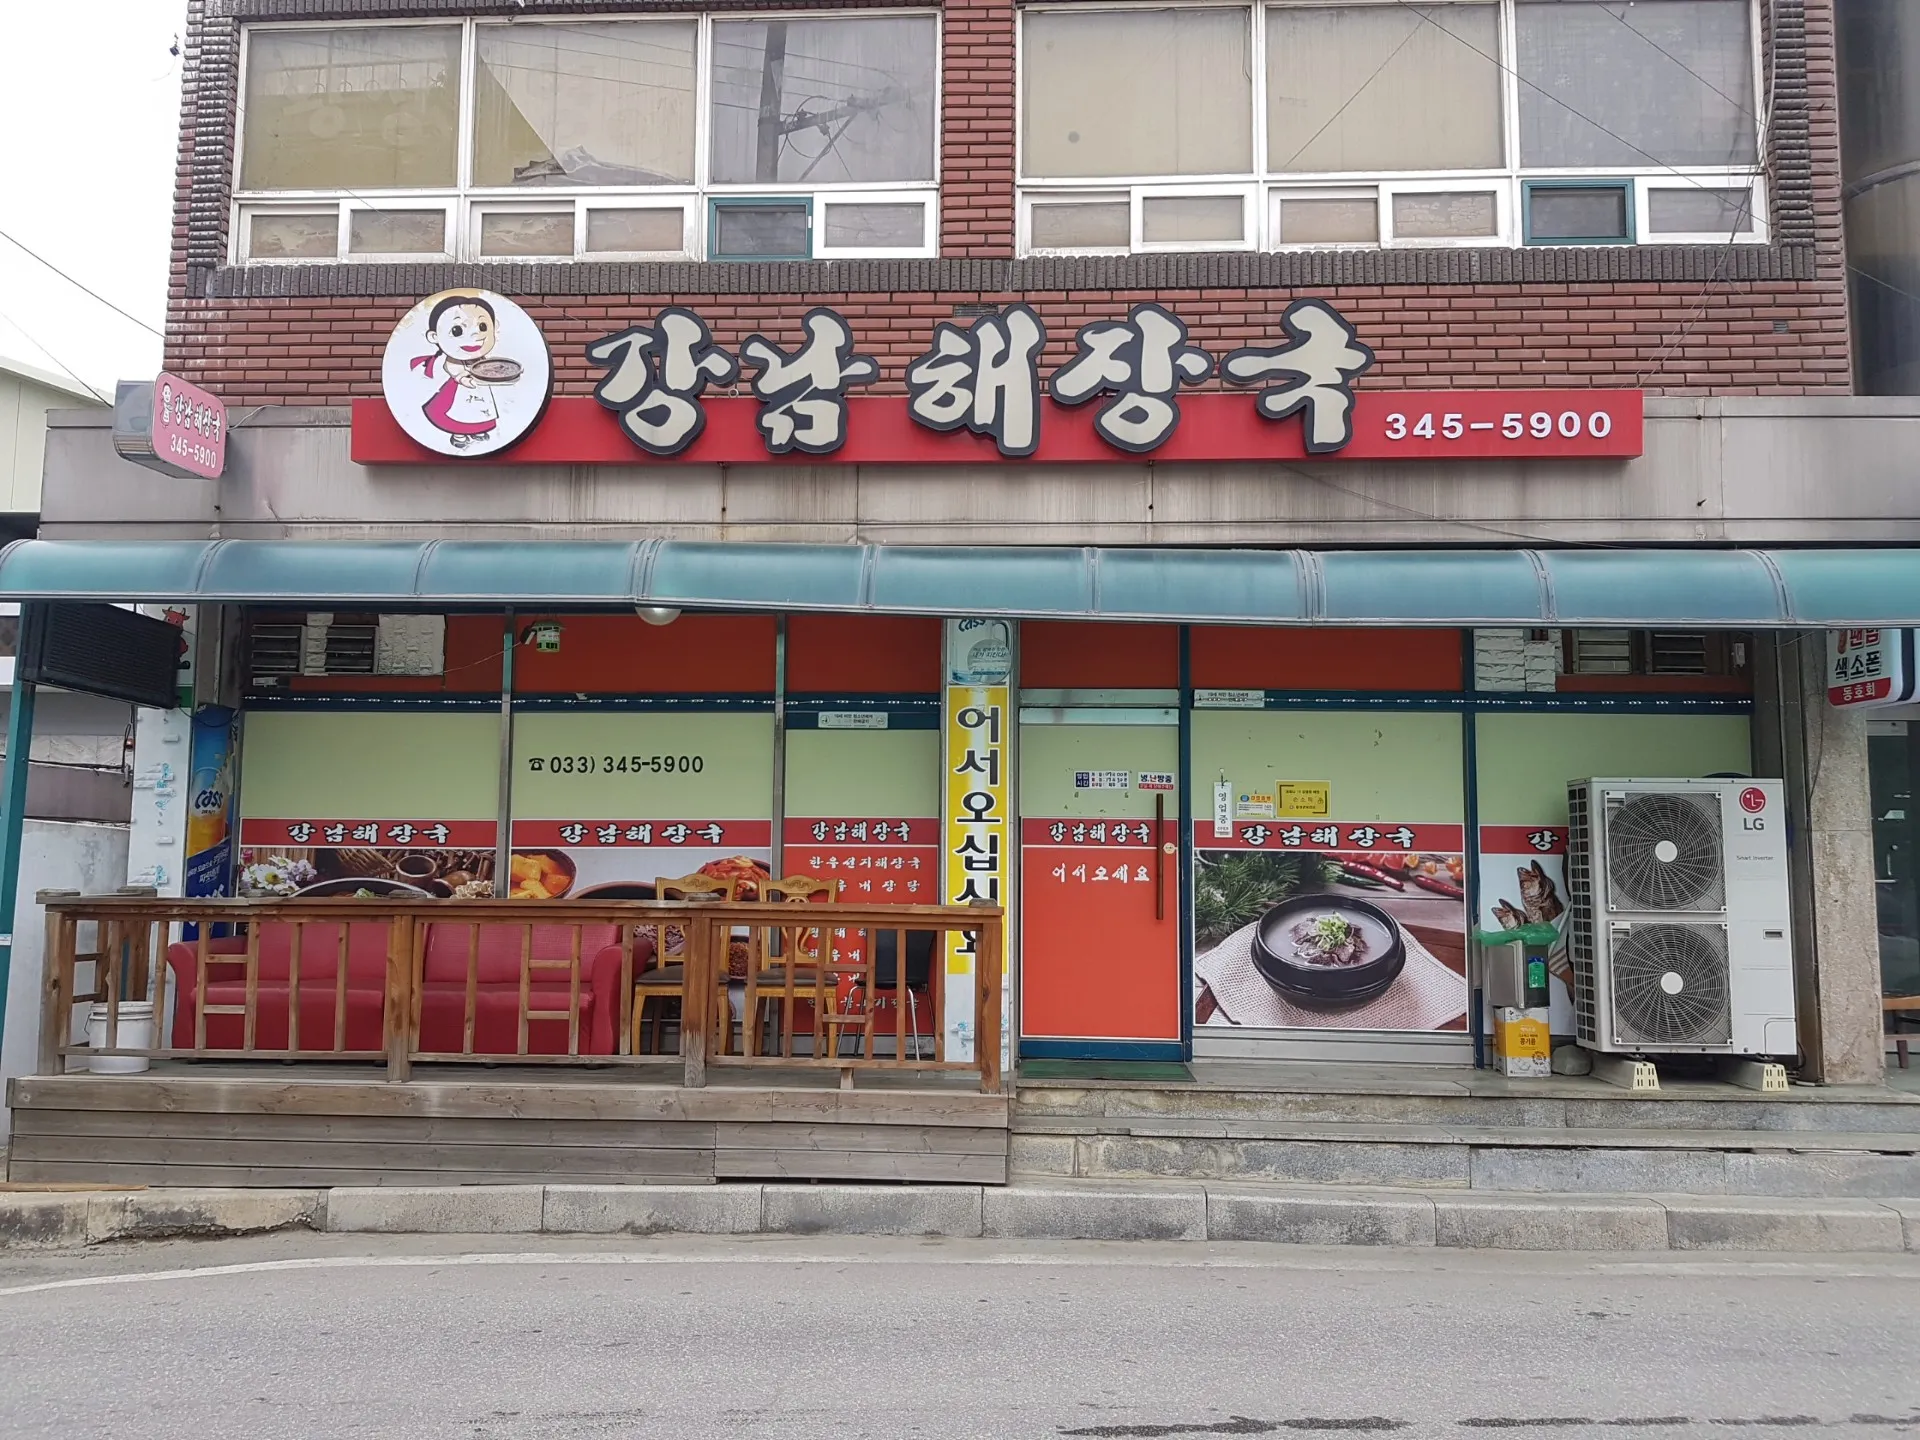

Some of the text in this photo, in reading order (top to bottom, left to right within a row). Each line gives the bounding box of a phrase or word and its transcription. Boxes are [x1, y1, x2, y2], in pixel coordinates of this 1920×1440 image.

[1385, 411, 1612, 440] 345-5900
[170, 434, 217, 468] 345-5900
[1835, 651, 1881, 680] 색소폰
[1843, 682, 1875, 701] 동호회
[550, 756, 704, 774] 033) 345-5900
[195, 789, 223, 809] Cass
[1218, 792, 1228, 824] 영업중
[287, 822, 451, 844] 강남해장국
[559, 823, 724, 844] 강남해장국
[811, 820, 910, 842] 강남해장국
[1049, 822, 1150, 843] 강남해장국
[1743, 818, 1765, 830] LG
[1240, 824, 1415, 848] 강남해장국
[1052, 862, 1150, 883] 어서오세요
